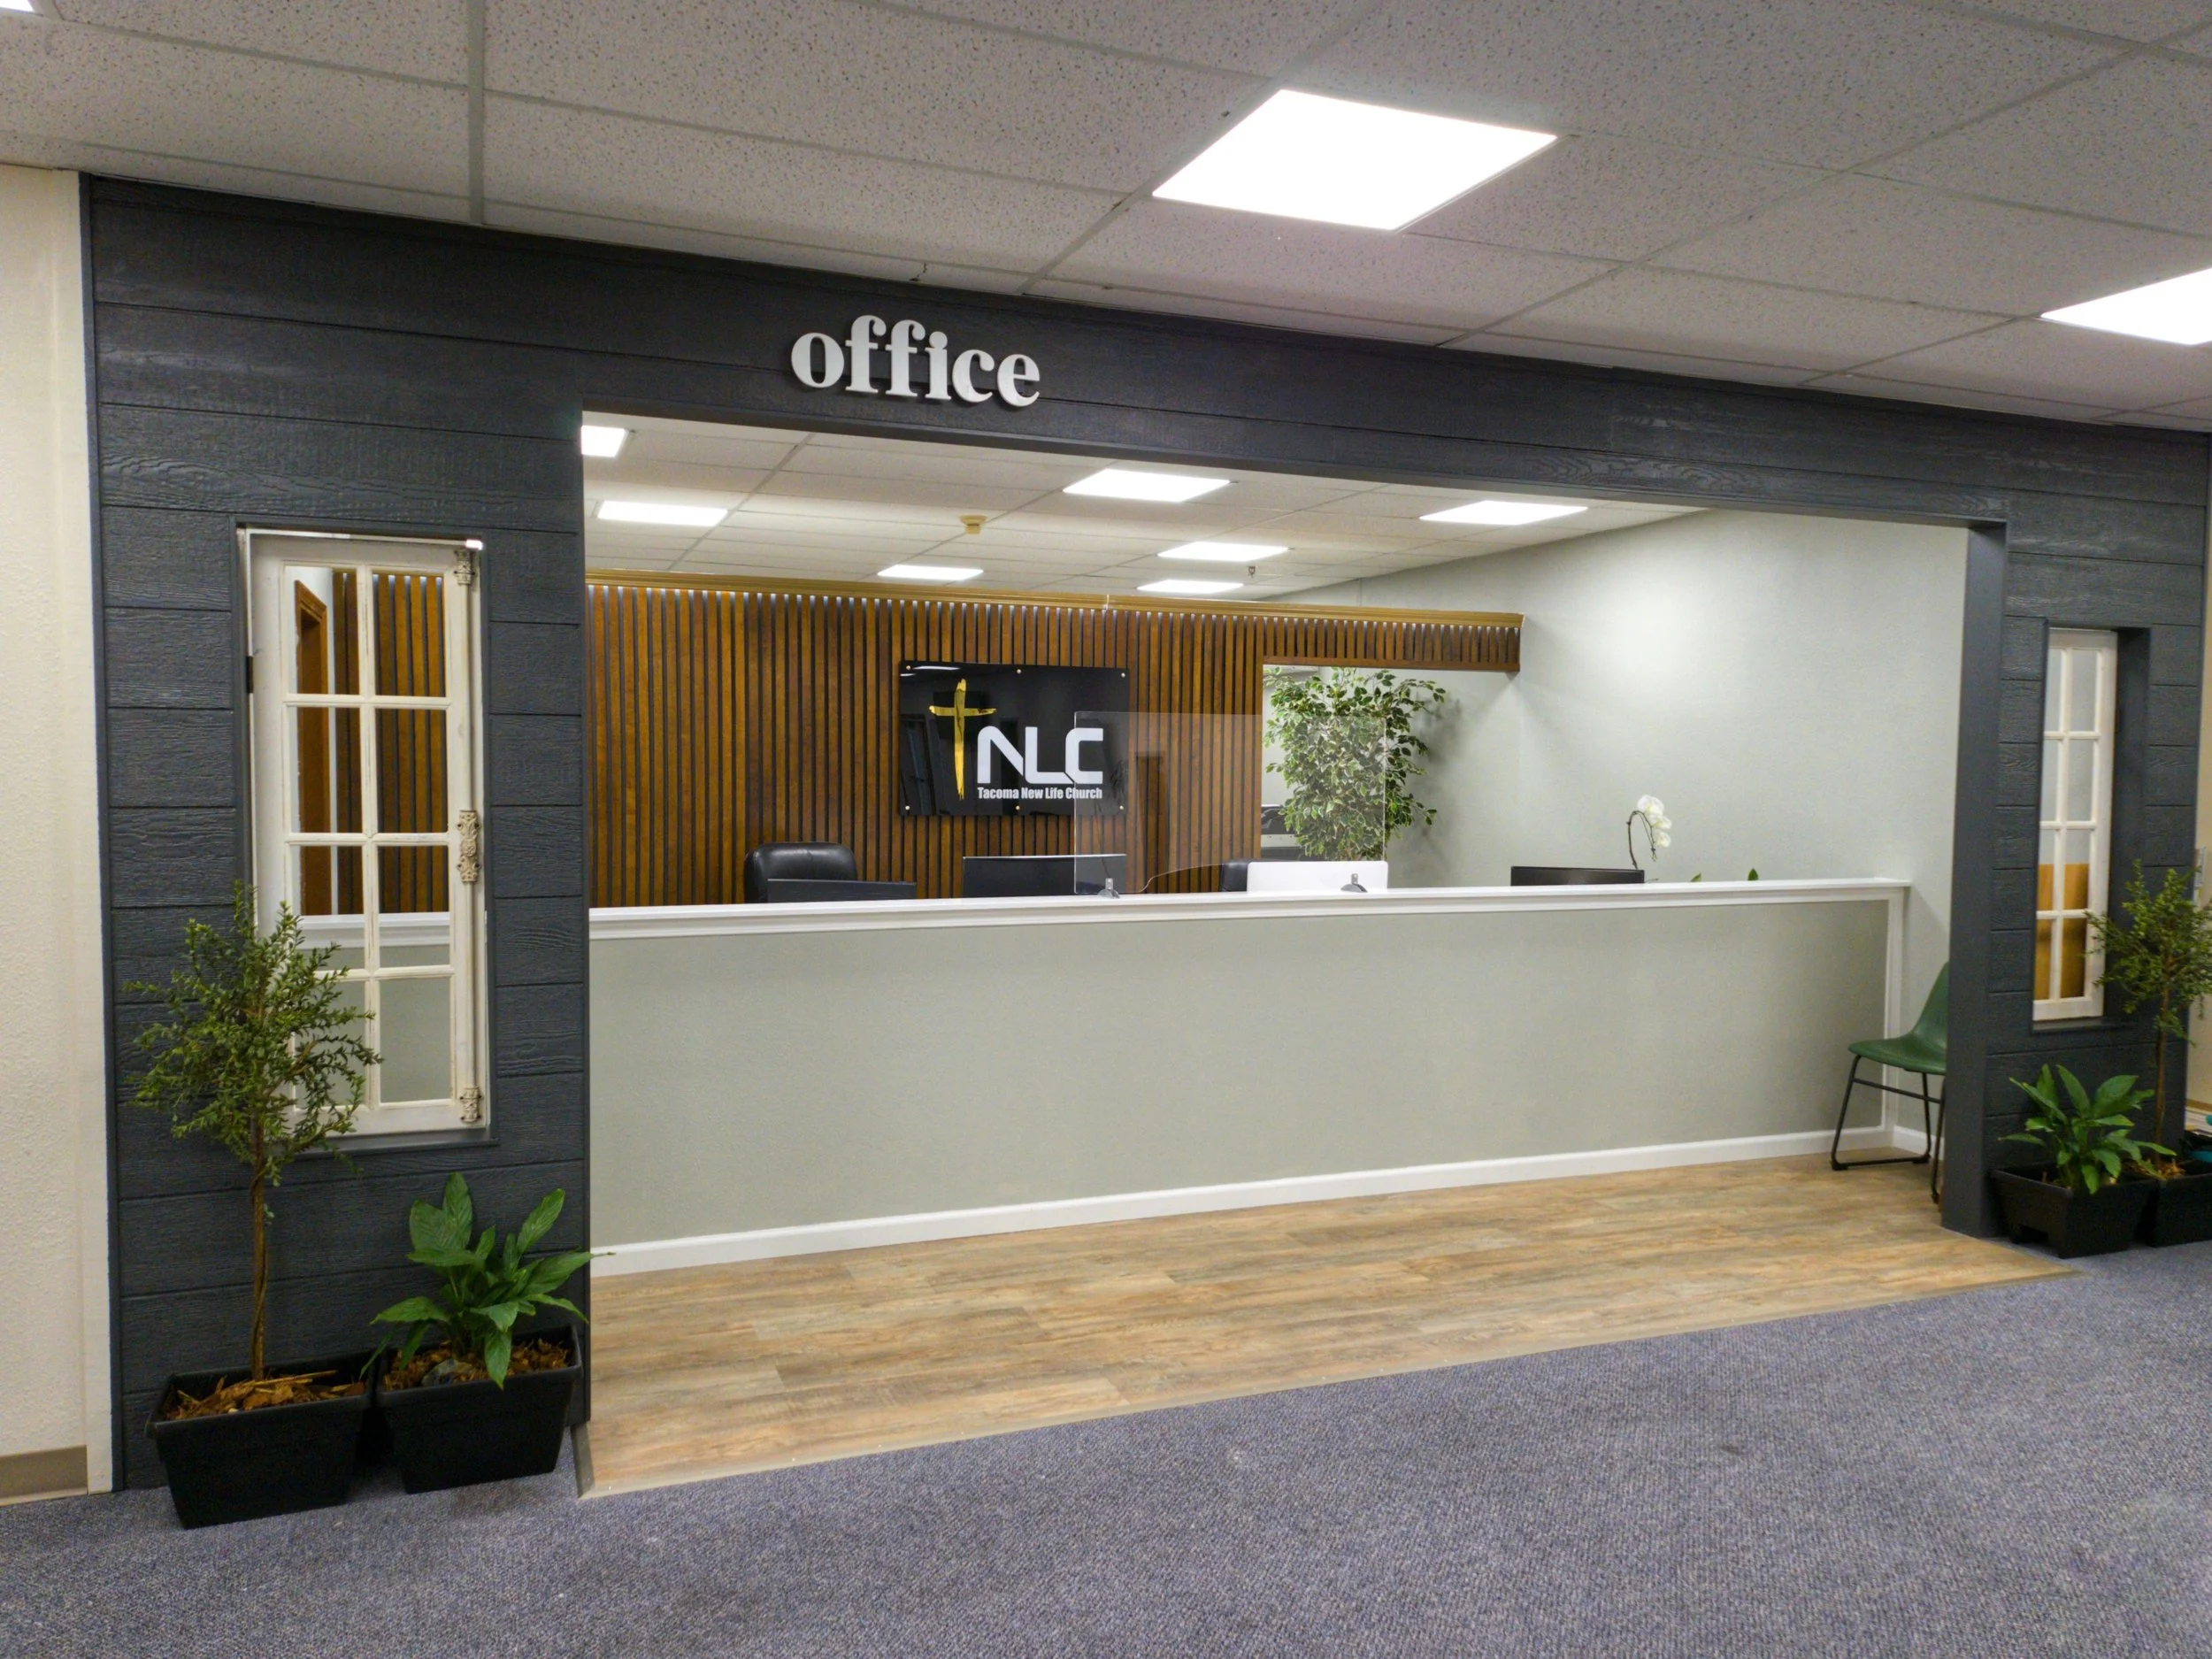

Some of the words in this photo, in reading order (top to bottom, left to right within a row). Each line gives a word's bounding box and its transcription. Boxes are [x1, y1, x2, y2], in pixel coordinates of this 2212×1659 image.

[791, 315, 1041, 407] office
[977, 726, 1104, 784] NLC
[977, 787, 1019, 800] Tacoma
[1021, 787, 1043, 800] New
[1045, 787, 1064, 800] Life
[1065, 787, 1103, 800] Church
